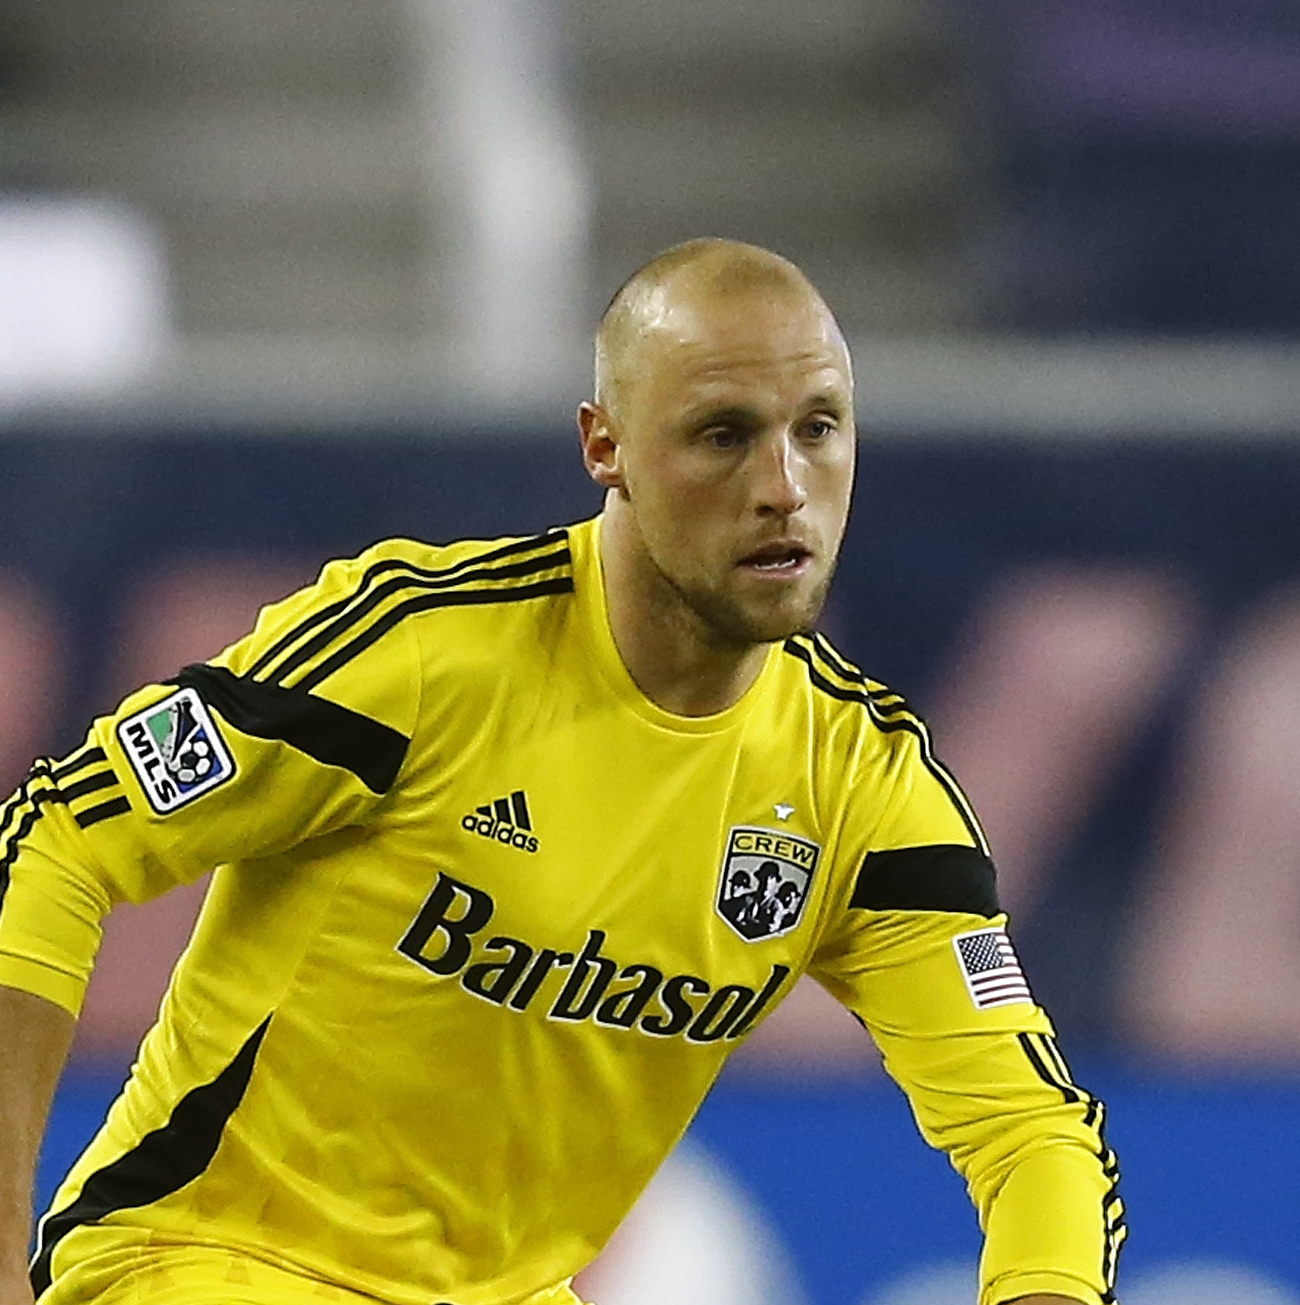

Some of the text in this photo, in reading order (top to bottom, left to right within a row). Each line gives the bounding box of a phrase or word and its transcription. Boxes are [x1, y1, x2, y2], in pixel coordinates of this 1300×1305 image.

[126, 722, 177, 804] MLS
[461, 812, 539, 853] adidas
[734, 835, 814, 864] CREW
[396, 871, 791, 1043] Barbasol
